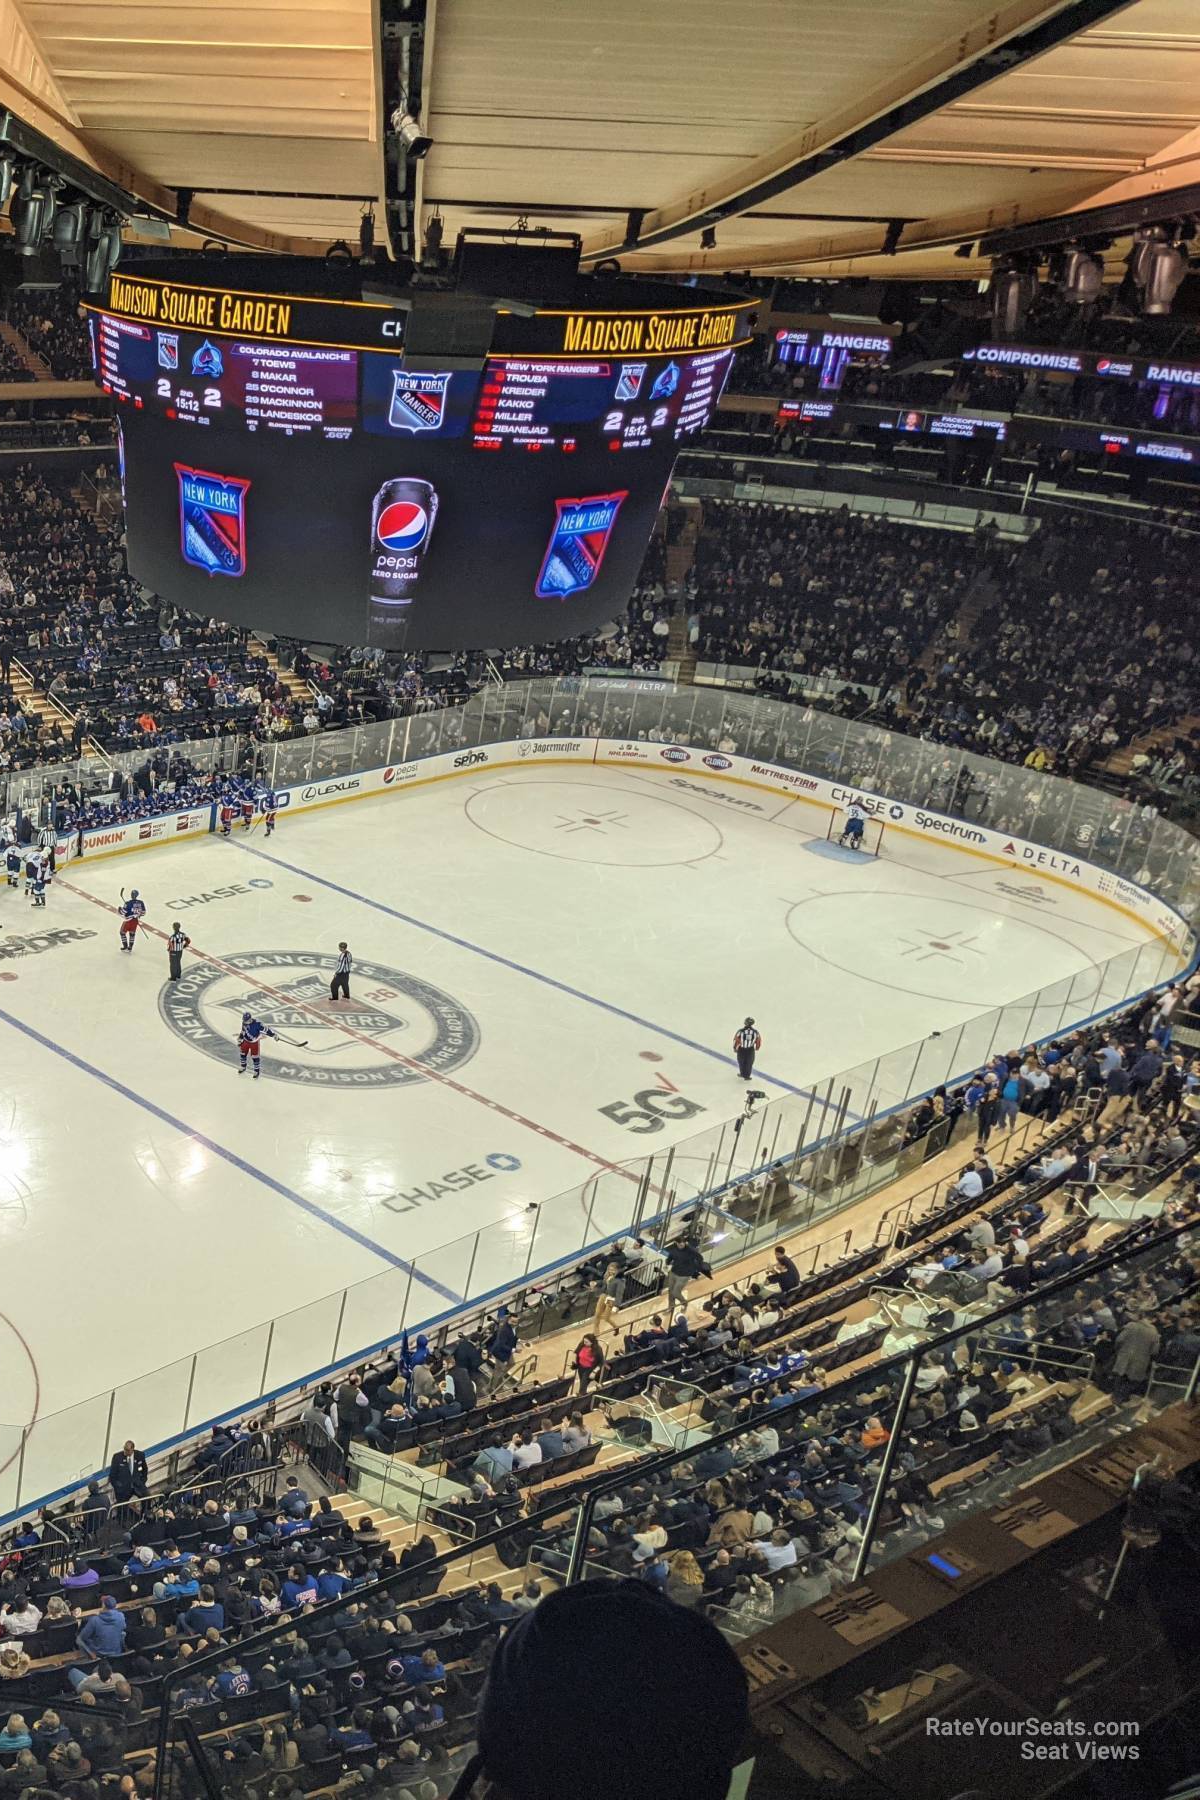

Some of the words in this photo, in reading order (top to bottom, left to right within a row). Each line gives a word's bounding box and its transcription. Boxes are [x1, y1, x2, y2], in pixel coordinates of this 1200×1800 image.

[110, 278, 157, 316] MADISON
[160, 286, 216, 326] SQUARE
[220, 294, 291, 335] GARDEN
[563, 316, 644, 351] MADISON
[645, 315, 699, 351] SQUARE
[698, 312, 737, 345] GARDEN
[787, 332, 809, 344] pepsi
[822, 334, 890, 351] RANGERS
[239, 346, 290, 358] COLORADO
[290, 349, 351, 361] AVALANCHE
[976, 348, 1081, 371] COMPROMISE.
[259, 359, 296, 369] TOEWS
[505, 362, 530, 371] NEW
[530, 364, 556, 373] YORK
[556, 364, 600, 374] RANGERS
[259, 371, 297, 382] MAKAR
[397, 377, 417, 389] NEW
[420, 379, 444, 390] YORK
[506, 374, 548, 383] TROUBA
[157, 378, 171, 398] 2
[260, 384, 314, 396] O'CONNOR
[502, 387, 546, 396] KREIDER
[175, 396, 199, 412] 15:12
[204, 388, 221, 408] 2
[260, 396, 323, 409] MACKINNON
[497, 399, 534, 409] KAKKO
[260, 409, 323, 422] LANDESKOG
[401, 392, 438, 425] RANGERS
[495, 412, 533, 421] MILLER
[651, 407, 668, 427] 2
[491, 424, 548, 435] ZIBANEJAD
[603, 411, 624, 431] 2
[623, 425, 647, 437] 15:12
[1100, 434, 1129, 444] SHOTS
[1136, 446, 1193, 461] RANGERS
[184, 481, 205, 501] NEW
[209, 489, 237, 510] YORK
[560, 512, 586, 530] NEW
[587, 508, 613, 527] YORK
[377, 555, 418, 570] pepsi
[372, 569, 391, 578] ZERO
[663, 750, 688, 760] CLOROX
[705, 757, 729, 768] CLOROX
[317, 779, 360, 796] LEXUS
[668, 778, 764, 812] Spectrum
[914, 811, 984, 843] Spectrum
[1023, 846, 1081, 877] DELTA
[165, 883, 253, 911] CHASE
[1116, 879, 1151, 904] Northwell
[172, 966, 223, 999] YORK
[287, 982, 328, 1000] YORK
[172, 1004, 211, 1040] NEW
[279, 1065, 387, 1082] MADISON
[445, 1004, 465, 1044] GARDEN
[598, 1088, 705, 1134] 5G
[381, 1163, 496, 1214] CHASE
